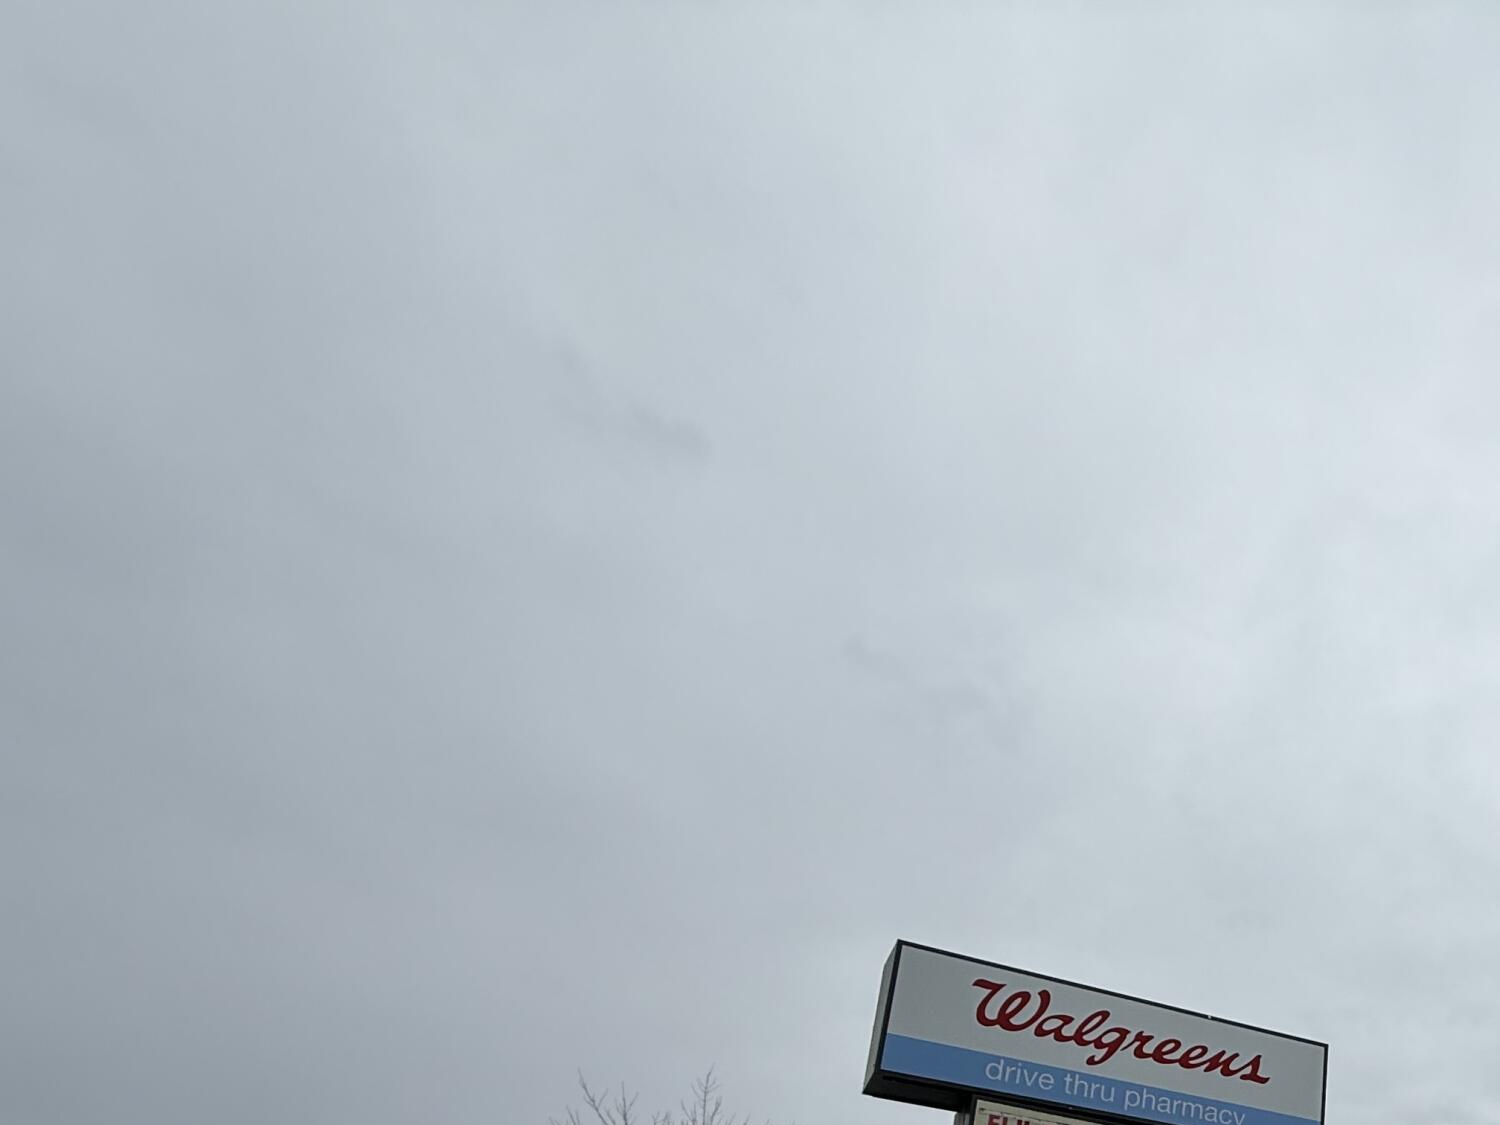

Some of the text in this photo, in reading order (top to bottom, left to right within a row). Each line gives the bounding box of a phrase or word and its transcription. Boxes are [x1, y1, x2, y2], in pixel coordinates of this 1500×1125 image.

[972, 978, 1271, 1085] Walgreens
[985, 1059, 1055, 1091] drive
[1064, 1073, 1116, 1103] thru
